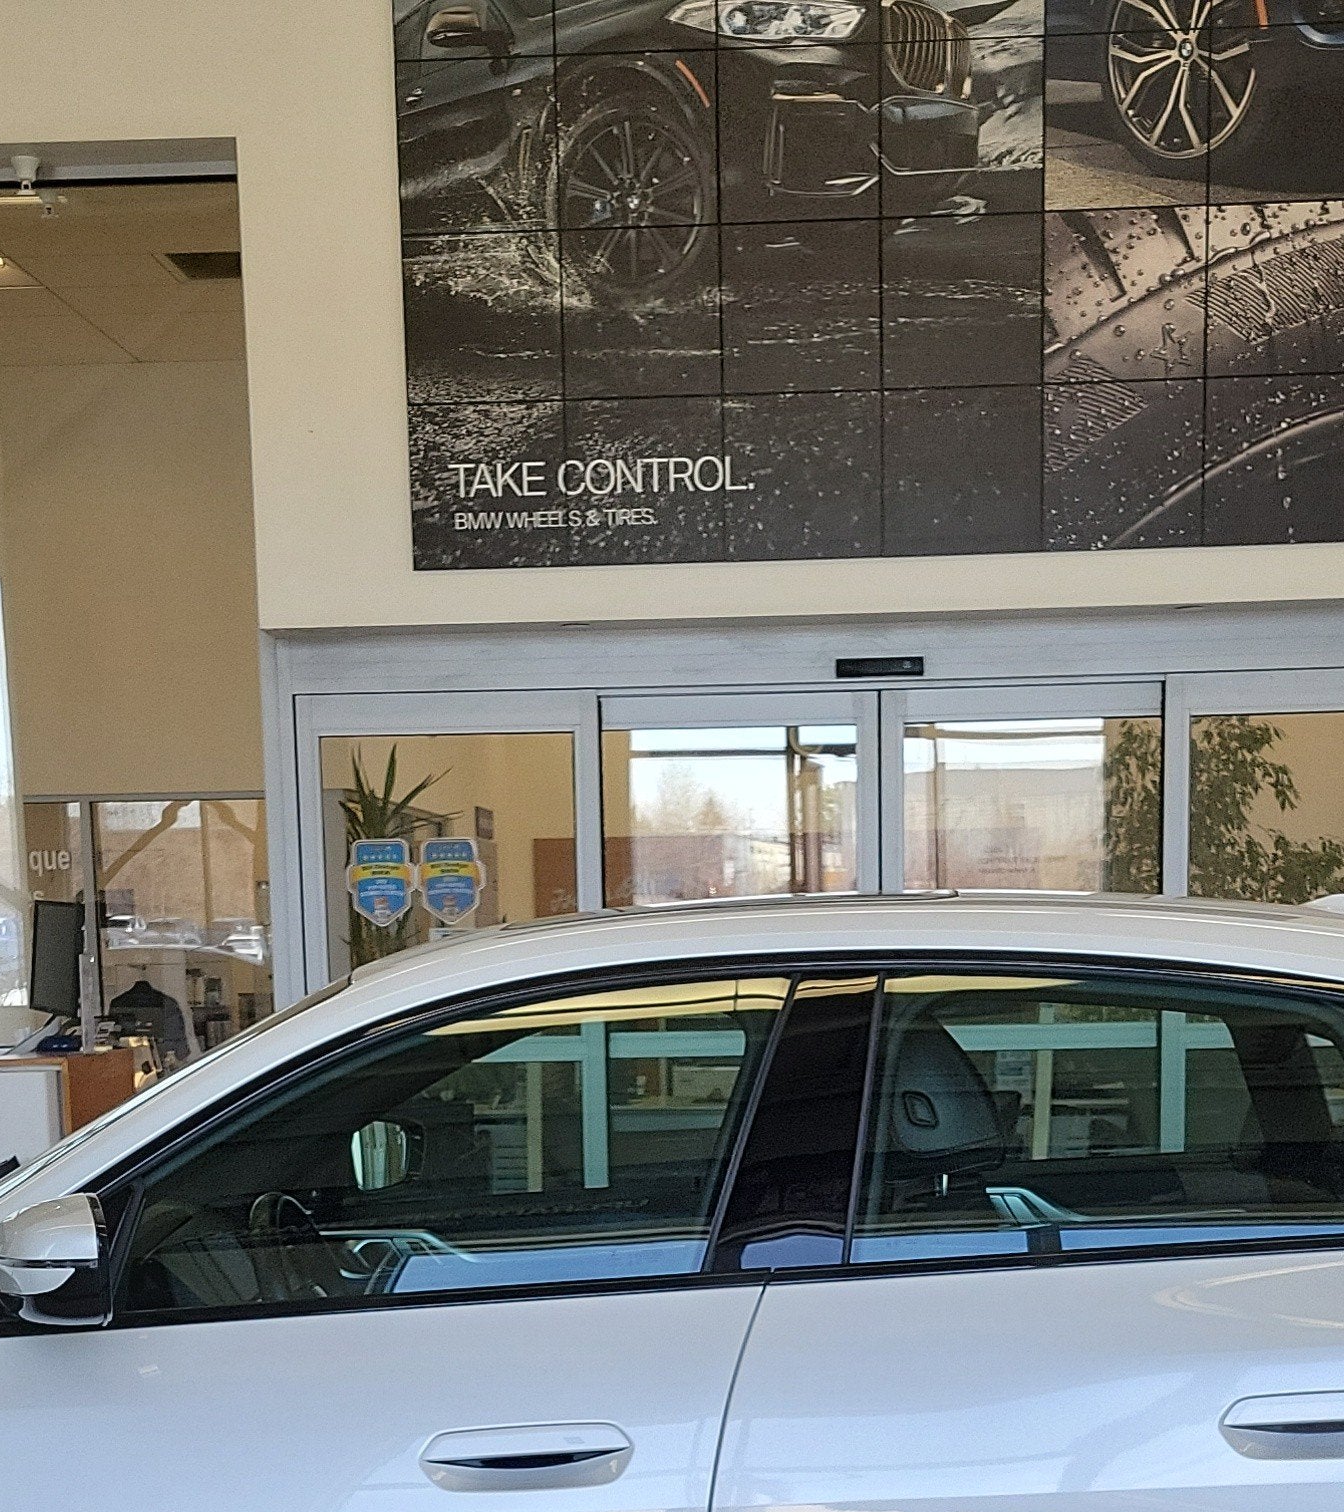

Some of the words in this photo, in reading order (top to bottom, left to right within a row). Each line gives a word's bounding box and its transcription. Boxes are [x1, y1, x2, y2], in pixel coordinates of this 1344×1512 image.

[447, 462, 547, 498] TAKE
[558, 456, 755, 496] CONTROL.
[454, 511, 504, 530] BMW
[505, 510, 582, 529] WHEELS
[585, 509, 601, 527] &
[29, 850, 71, 877] que
